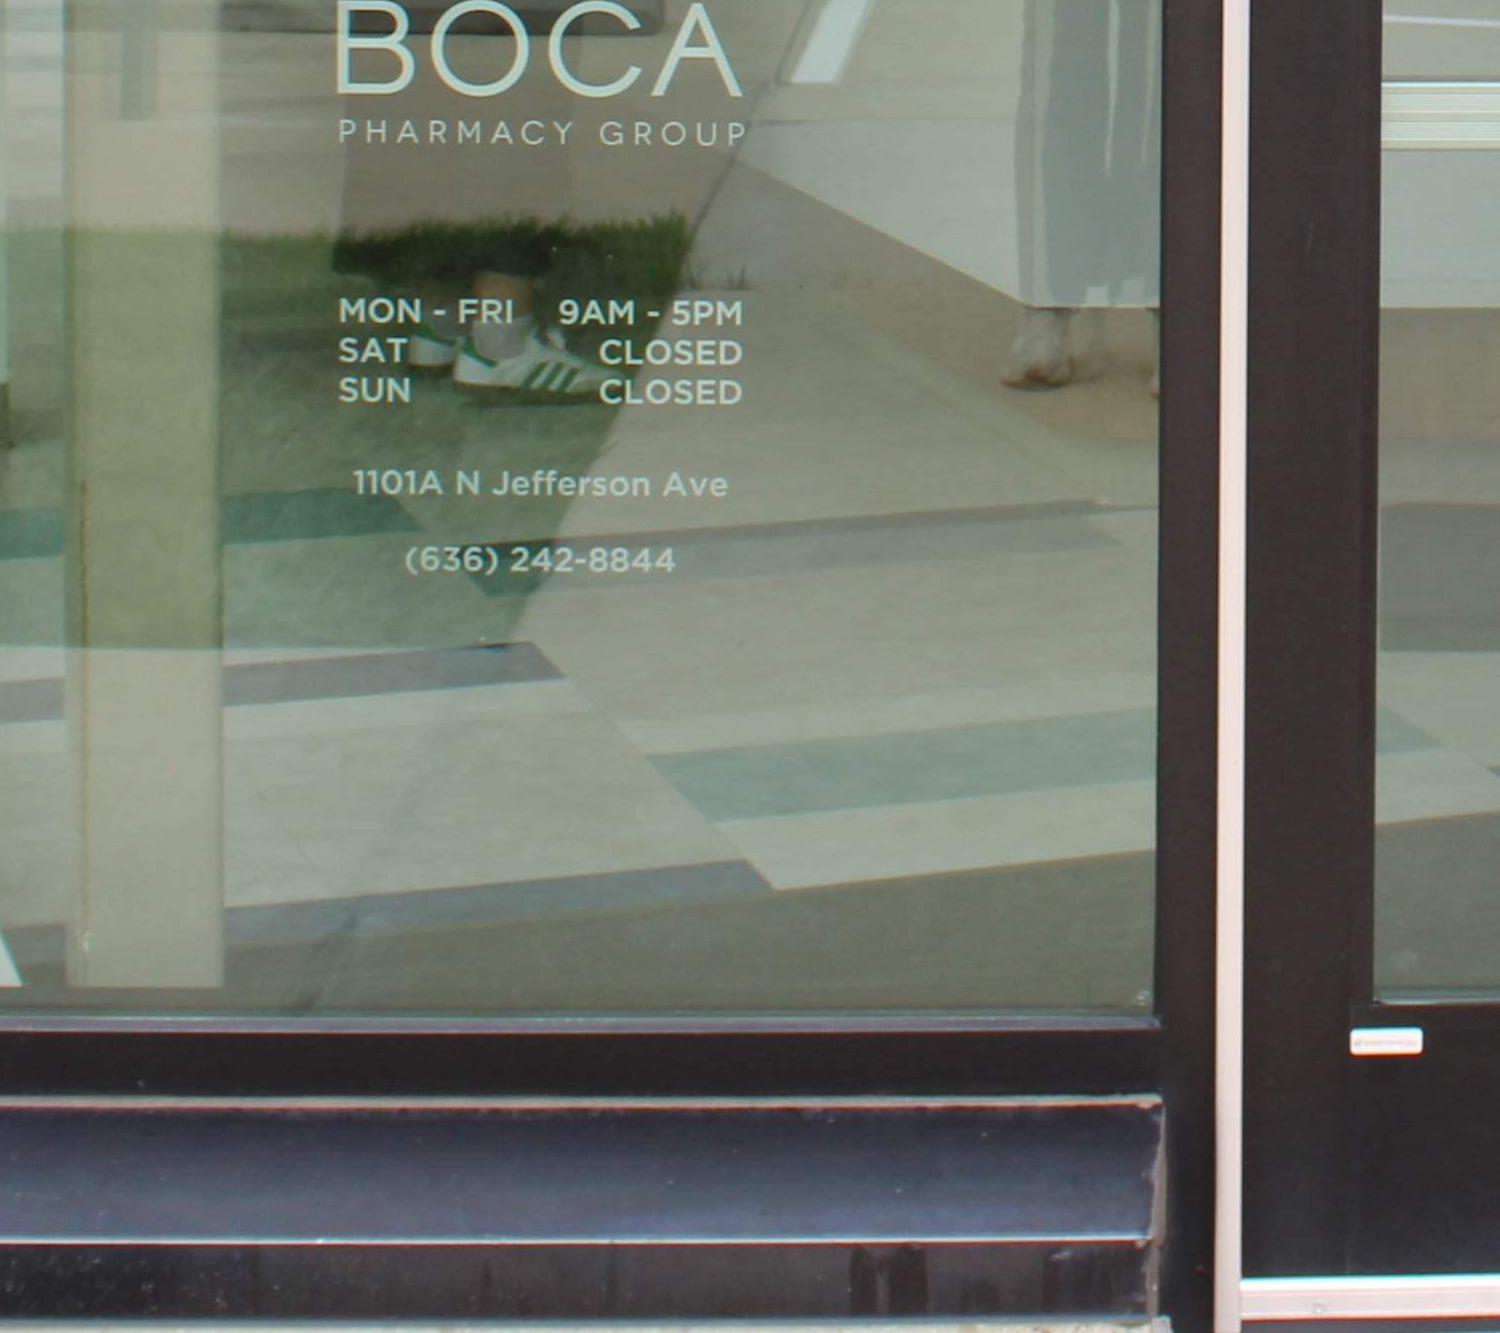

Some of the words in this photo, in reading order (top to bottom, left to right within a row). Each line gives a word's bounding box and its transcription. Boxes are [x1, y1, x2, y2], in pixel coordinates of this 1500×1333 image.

[336, 0, 741, 95] BOCA
[340, 120, 573, 145] PHARMACY
[599, 122, 747, 146] GROUP
[340, 298, 421, 323] MON
[457, 299, 514, 324] FRI
[560, 299, 635, 325] 9AM
[671, 300, 742, 325] 5PM
[340, 338, 406, 364] SAT
[599, 340, 742, 366] CLOSED
[339, 378, 410, 403] SUN
[599, 379, 742, 405] CLOSED
[353, 470, 442, 496] 1101A
[456, 470, 479, 496] N
[492, 470, 650, 497] Jefferson
[662, 471, 728, 497] Ave
[405, 546, 497, 575] (636)
[510, 546, 674, 573] 242-8844
